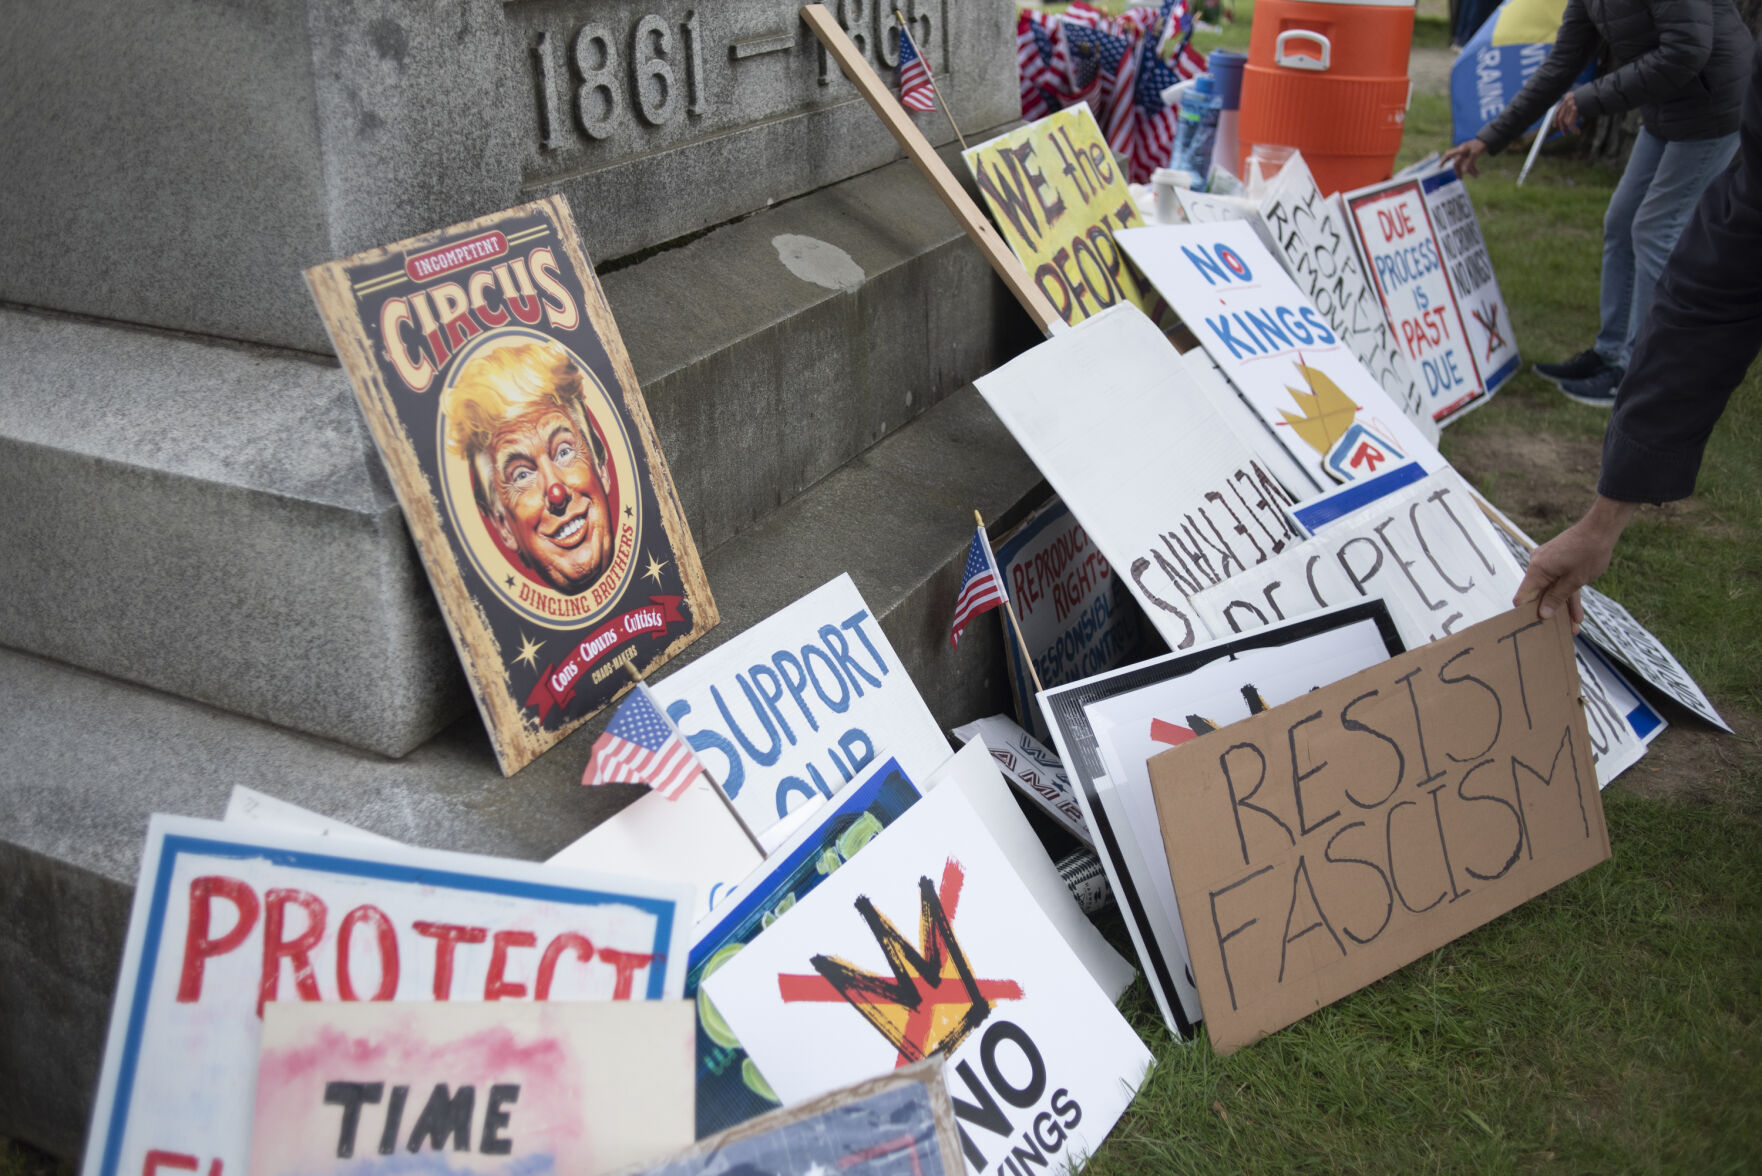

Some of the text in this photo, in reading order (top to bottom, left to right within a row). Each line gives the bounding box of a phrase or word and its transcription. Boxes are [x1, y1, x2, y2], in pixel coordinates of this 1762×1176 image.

[532, 10, 704, 153] 1861
[976, 125, 1113, 253] WE the
[1377, 202, 1415, 242] DUE
[413, 236, 500, 278] INCOMPETENT
[1181, 242, 1253, 286] NO
[1374, 237, 1440, 294] PROCESS
[381, 246, 579, 393] CIRCUS
[1205, 305, 1336, 360] KINGS
[1401, 305, 1451, 360] PAST
[1413, 285, 1430, 311] IS
[1421, 349, 1465, 398] DUE
[518, 522, 634, 617] DINGLING BROTHERS
[1052, 550, 1111, 625] RIGHTS
[551, 609, 663, 692] Cons Clowns Cultists
[591, 644, 638, 685] CHAOS-MAKERS
[665, 609, 889, 801] SUPPORT
[1220, 621, 1544, 865] RESIST
[1208, 724, 1589, 1012] FASCISM
[176, 875, 664, 1021] PROTECT
[323, 1080, 521, 1159] TIME
[951, 1020, 1047, 1174] NO
[995, 1087, 1082, 1176] INGS
